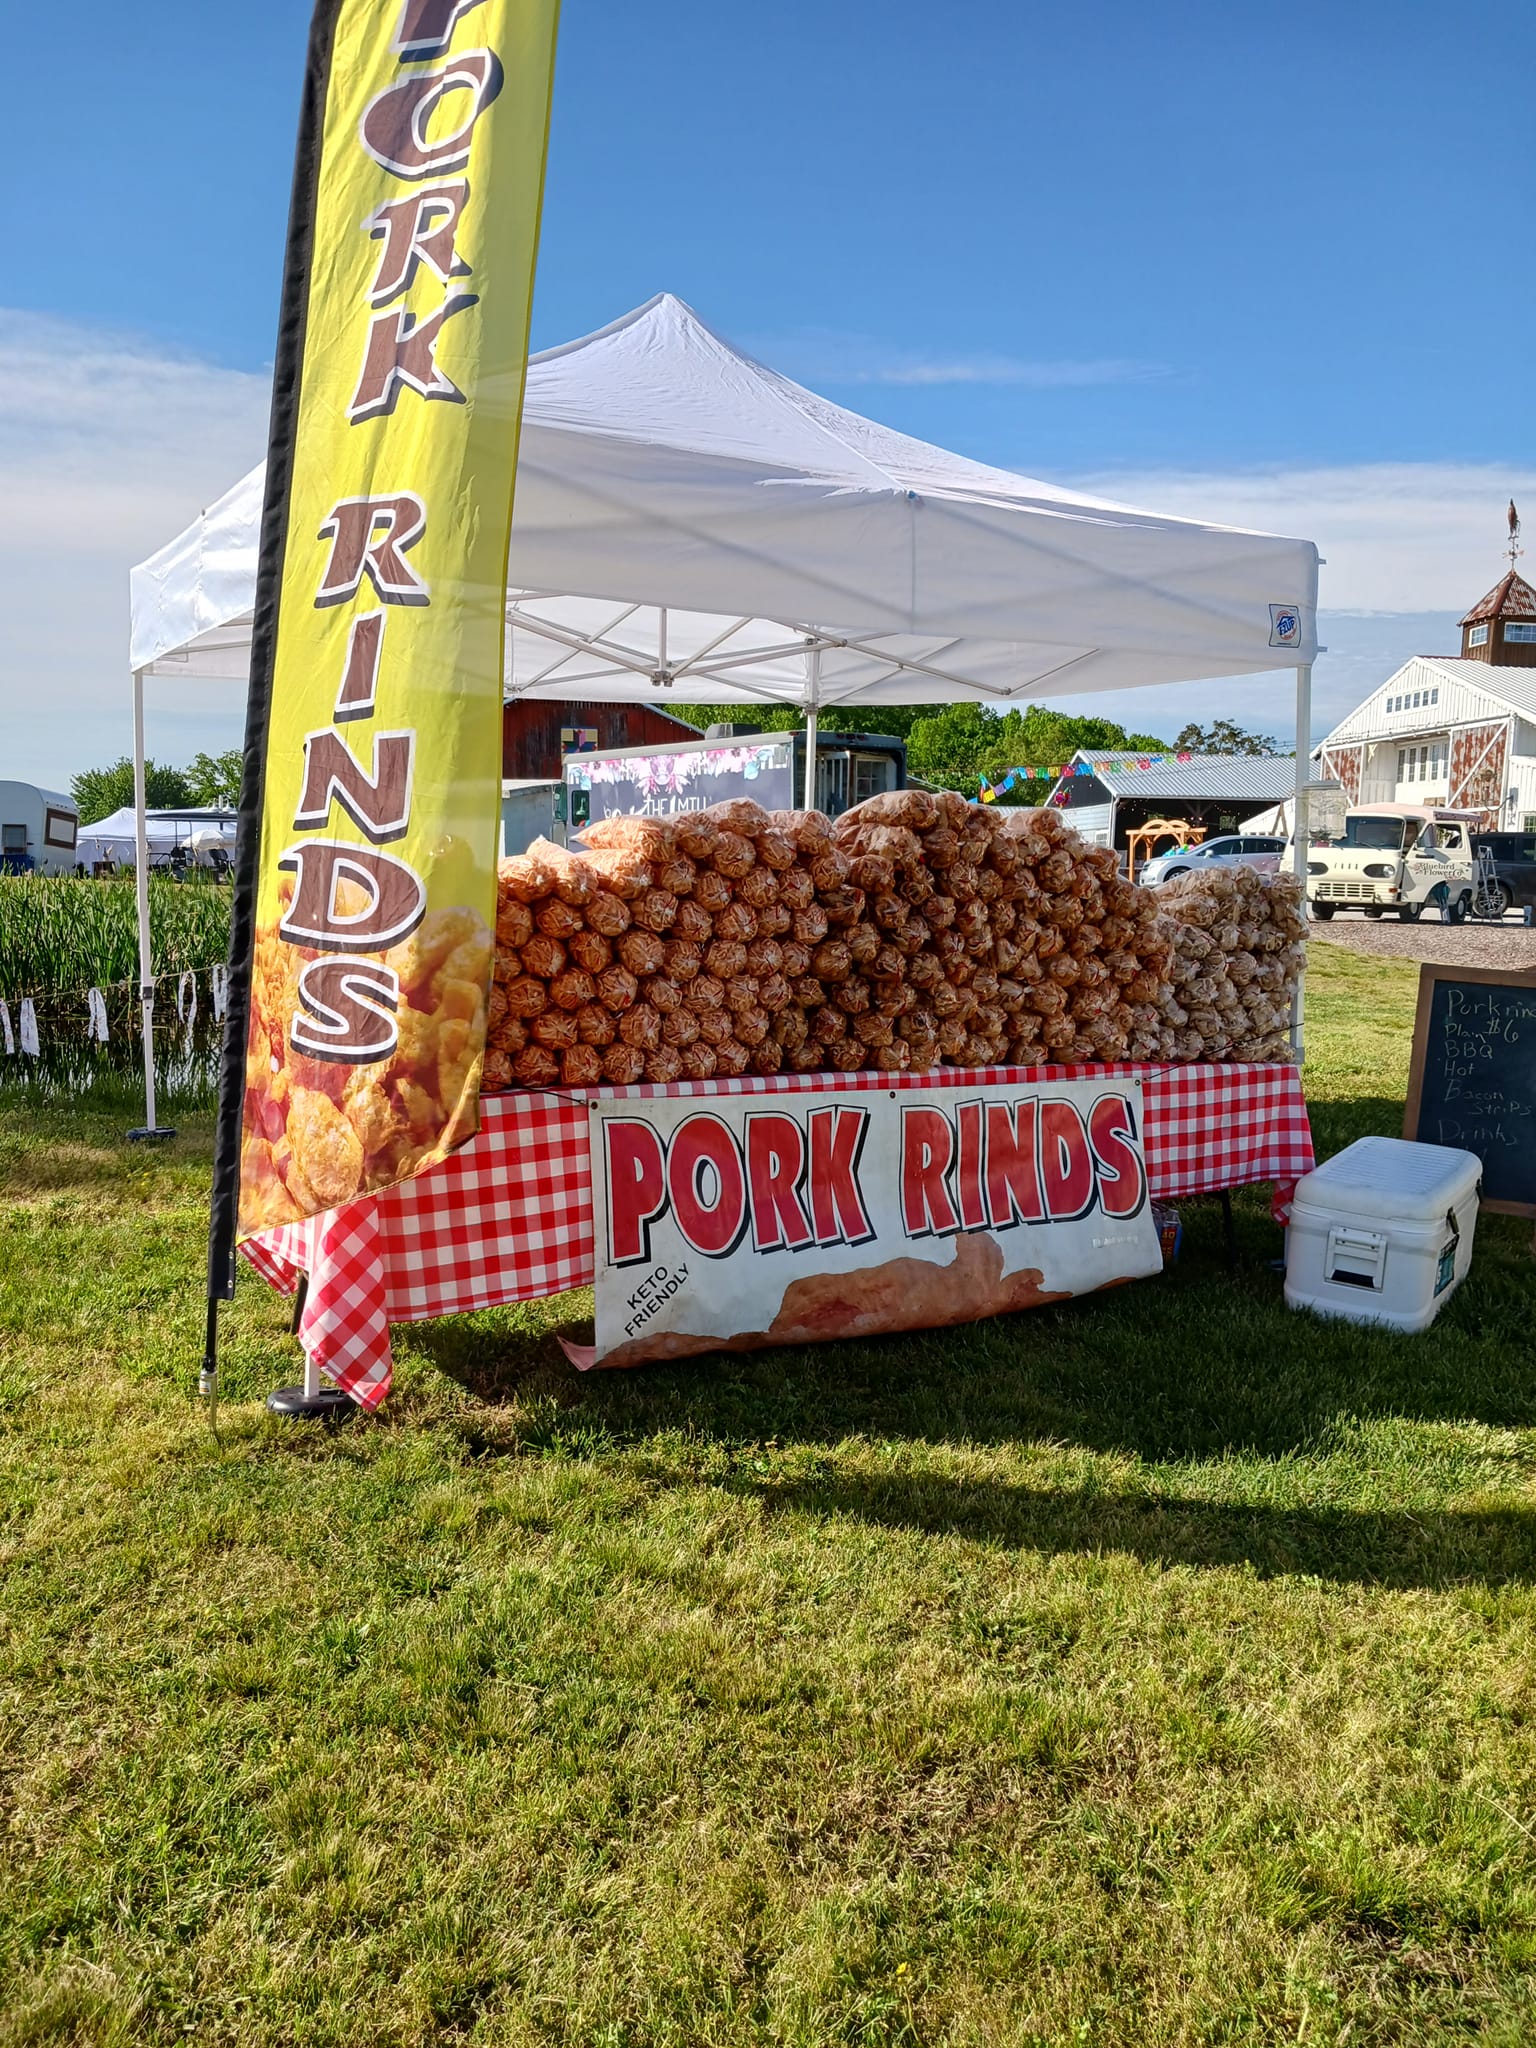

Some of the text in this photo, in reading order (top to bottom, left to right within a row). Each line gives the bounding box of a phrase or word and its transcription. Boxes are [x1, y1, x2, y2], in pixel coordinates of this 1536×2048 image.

[278, 490, 432, 1065] RINDS
[1445, 1023, 1487, 1043] Plain
[1444, 1039, 1493, 1060] BBQ
[1444, 1059, 1475, 1077] Hot
[1444, 1079, 1504, 1102] Bacon
[1438, 1119, 1519, 1146] Drinks
[602, 1091, 1146, 1268] PORK RINDS
[624, 1262, 689, 1337] FRIENDLY
[626, 1266, 668, 1310] KETO
